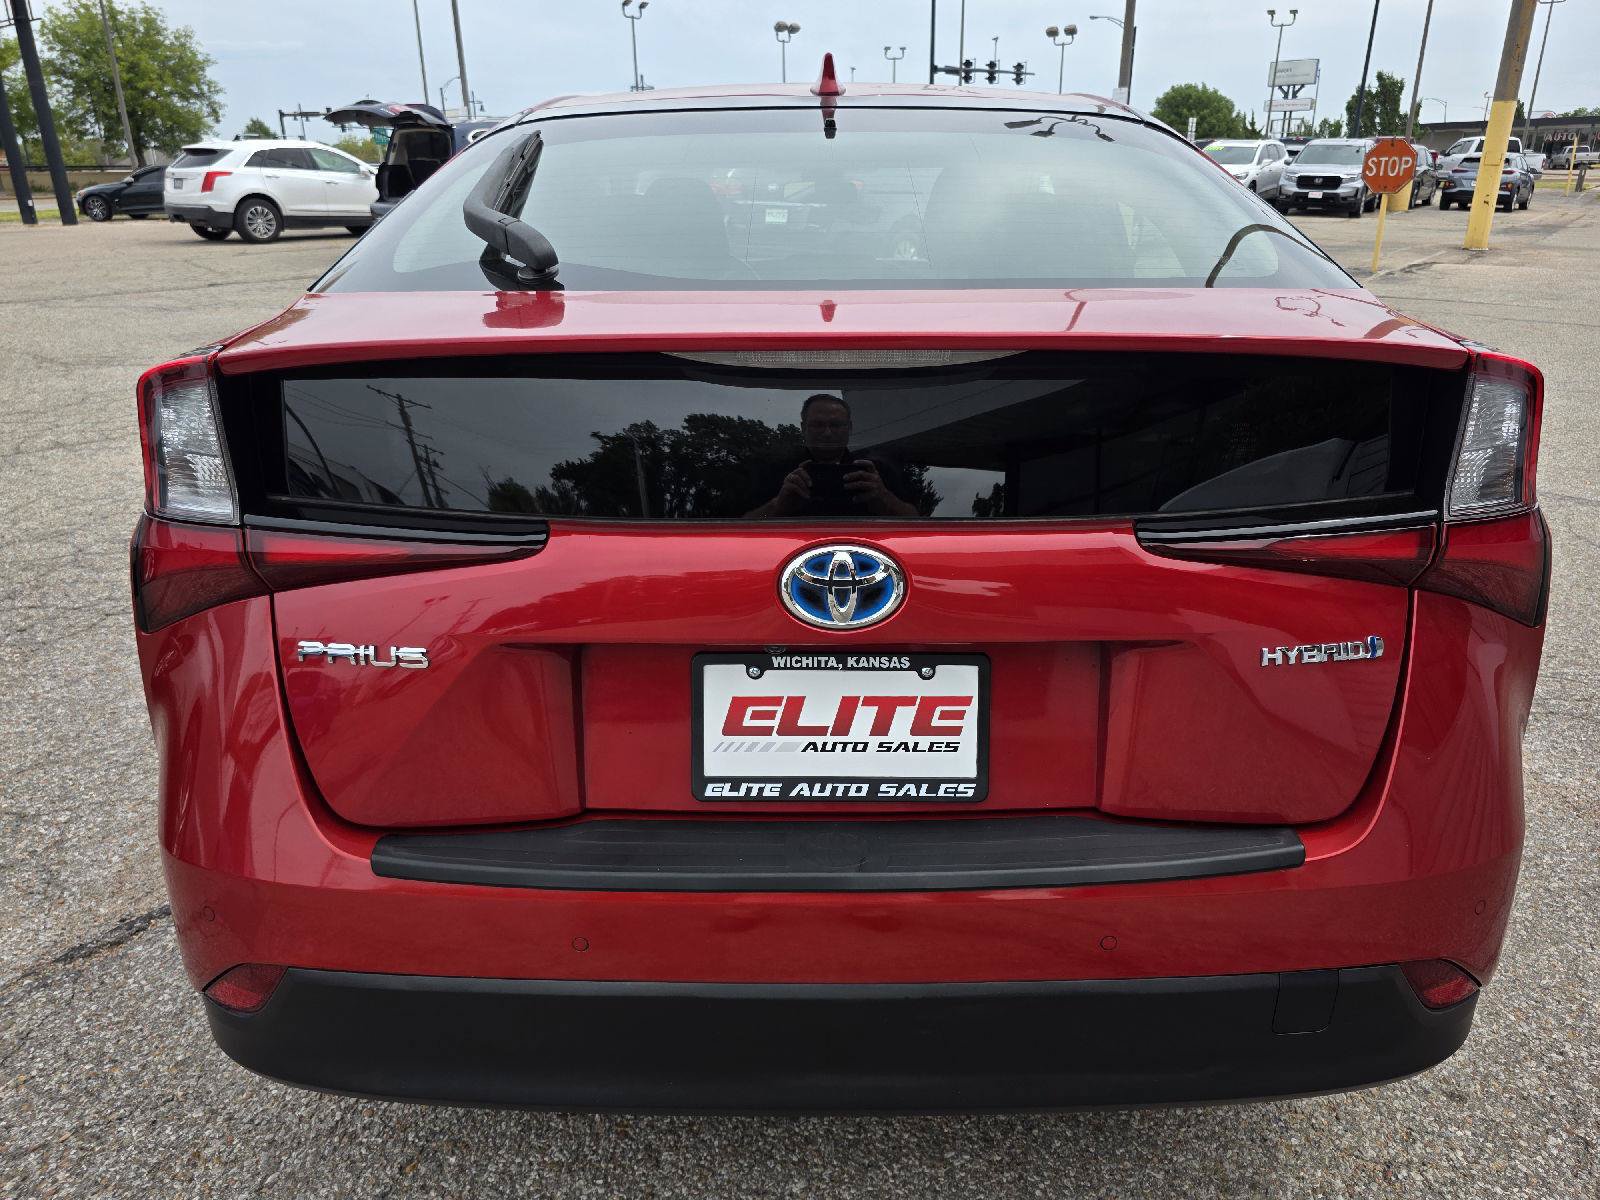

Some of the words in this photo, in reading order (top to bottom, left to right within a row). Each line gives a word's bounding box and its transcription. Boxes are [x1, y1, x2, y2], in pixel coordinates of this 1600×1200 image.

[1543, 131, 1577, 142] AUTO
[1365, 155, 1413, 177] STOP
[297, 640, 429, 669] PRIUS
[1261, 641, 1368, 667] HYBRID
[772, 656, 843, 671] WICHITA,
[847, 656, 911, 669] KANSAS
[721, 695, 974, 737] ELITE
[801, 741, 870, 753] AUTO
[876, 741, 961, 753] SALES
[704, 783, 784, 798] ELITE
[789, 783, 870, 798] AUTO
[877, 783, 977, 798] SALES
